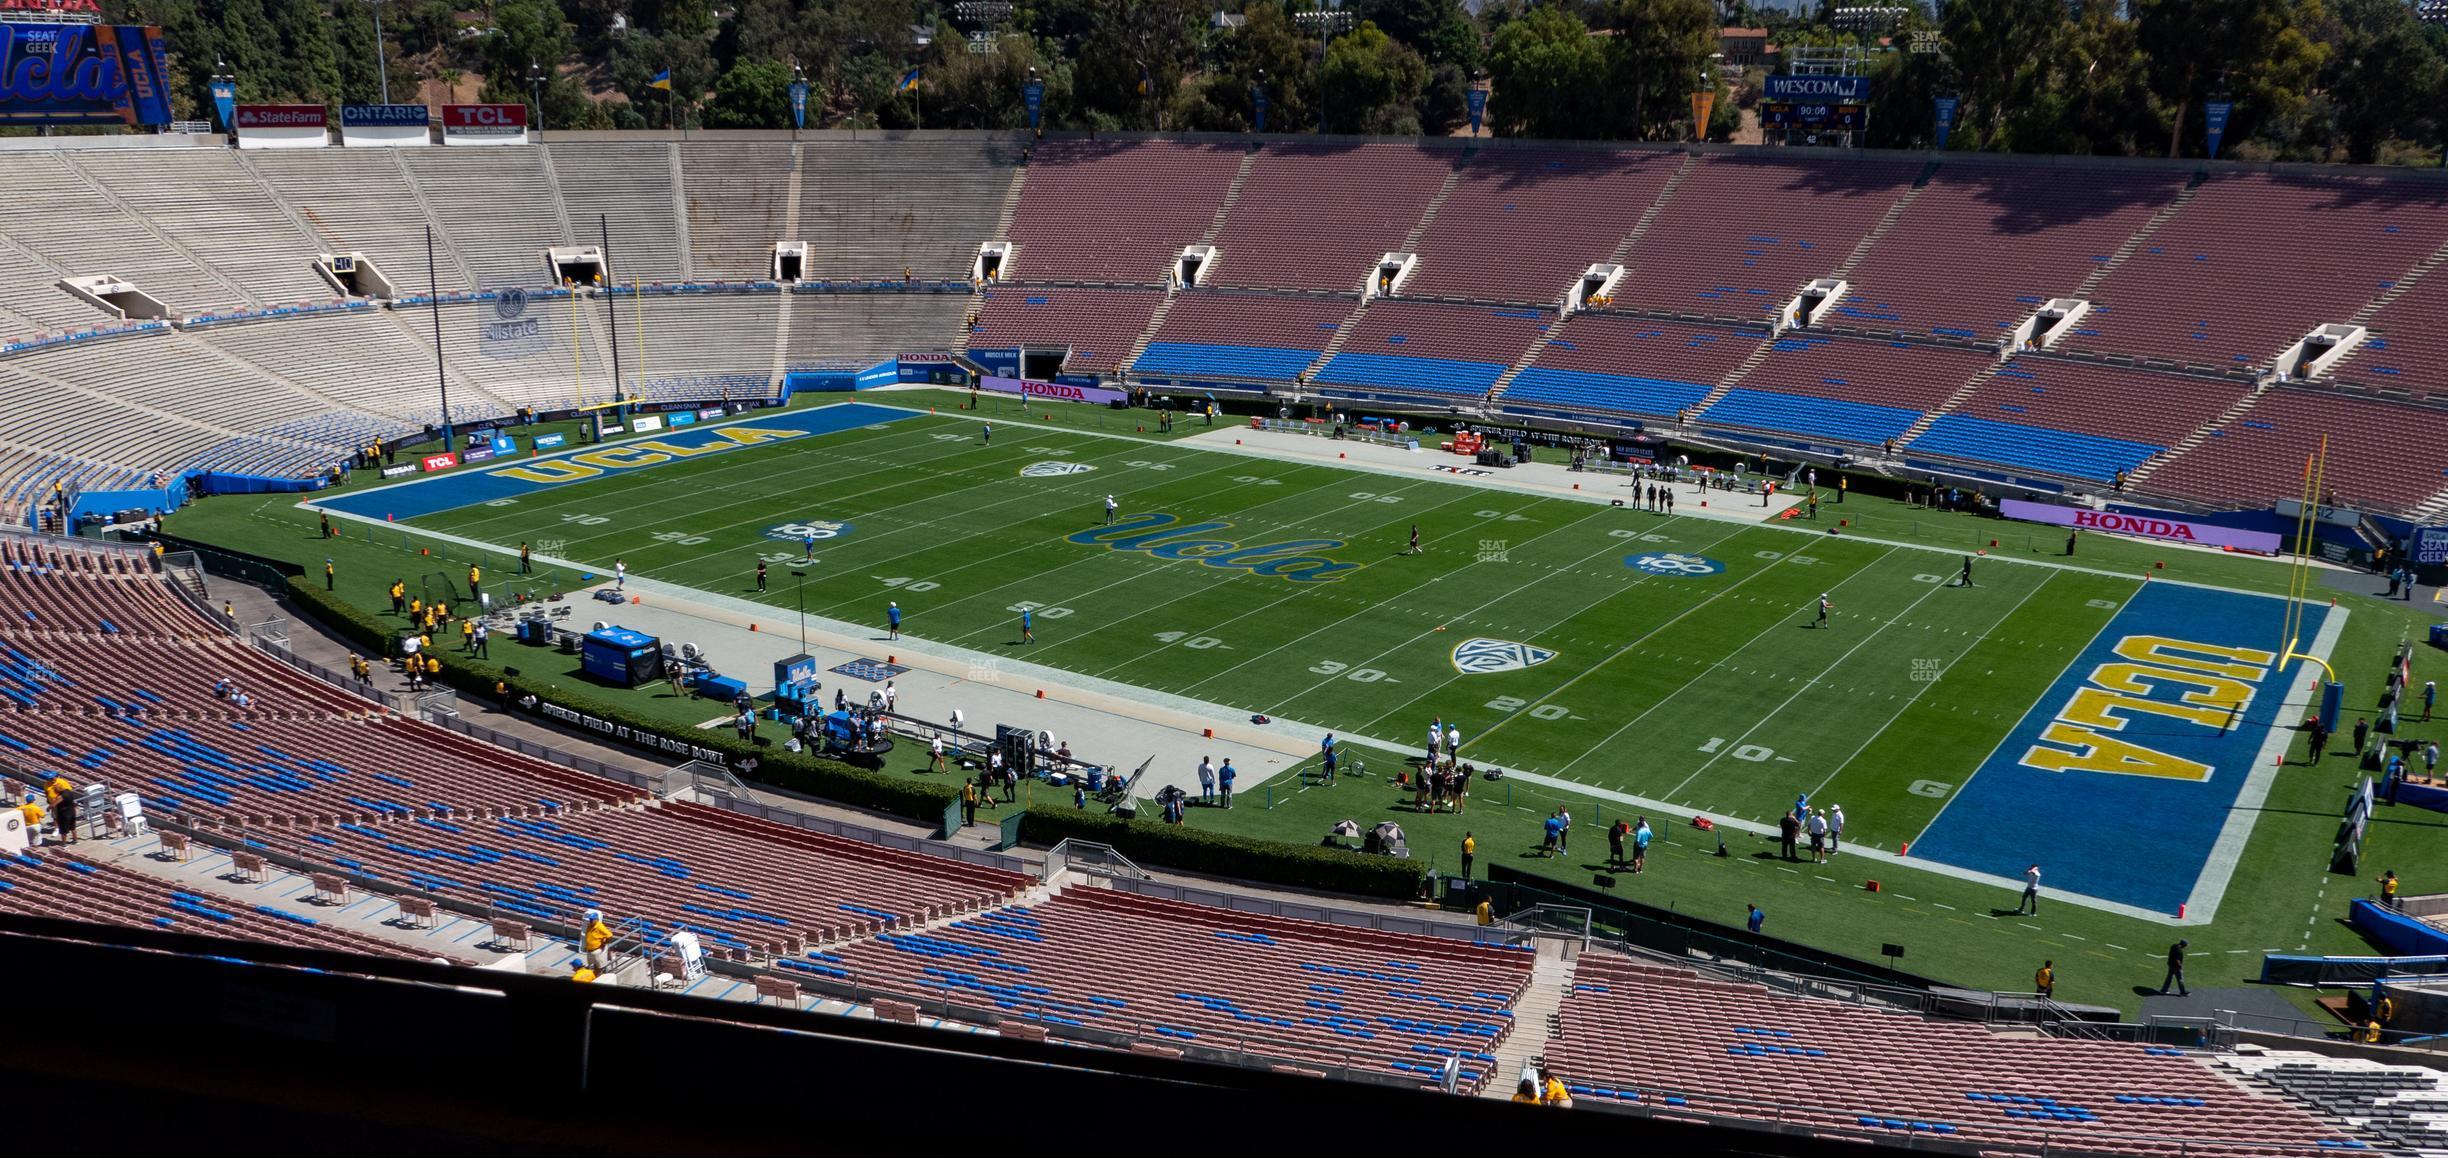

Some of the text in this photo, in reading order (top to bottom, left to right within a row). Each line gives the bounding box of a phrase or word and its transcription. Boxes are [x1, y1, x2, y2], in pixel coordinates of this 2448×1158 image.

[128, 48, 153, 99] UCLA
[1774, 80, 1838, 94] WESCOM
[344, 106, 426, 120] ONTARIO
[458, 107, 512, 124] TCL
[1775, 114, 1851, 124] 0 0
[1801, 107, 1826, 115] 90:00
[1807, 136, 1817, 144] 42
[335, 257, 353, 270] 40
[485, 320, 539, 341] Allstate
[985, 351, 1017, 359] MUSCLE MILK
[1021, 382, 1085, 399] HONDA
[1470, 425, 1501, 435] SPIEKER
[1503, 428, 1527, 438] FIELD
[428, 457, 453, 468] TCL
[486, 427, 811, 483] UCLA
[383, 464, 416, 476] NISSAN
[562, 513, 611, 525] 10
[2074, 511, 2195, 539] HONDA
[652, 532, 711, 545] 20
[771, 523, 838, 538] 100
[1063, 513, 1366, 582] Ucla
[1636, 556, 1714, 573] 100
[1640, 565, 1687, 576] YEARS
[881, 577, 941, 592] 40
[1153, 631, 1222, 649] 40
[1308, 660, 1388, 682] 30
[1482, 695, 1570, 720] 20
[2017, 635, 2278, 783] UCLA
[542, 703, 726, 766] SPIEKER FIELD AT THE ROSE BOWL
[1697, 737, 1774, 762] 10
[1907, 779, 1953, 798] G
